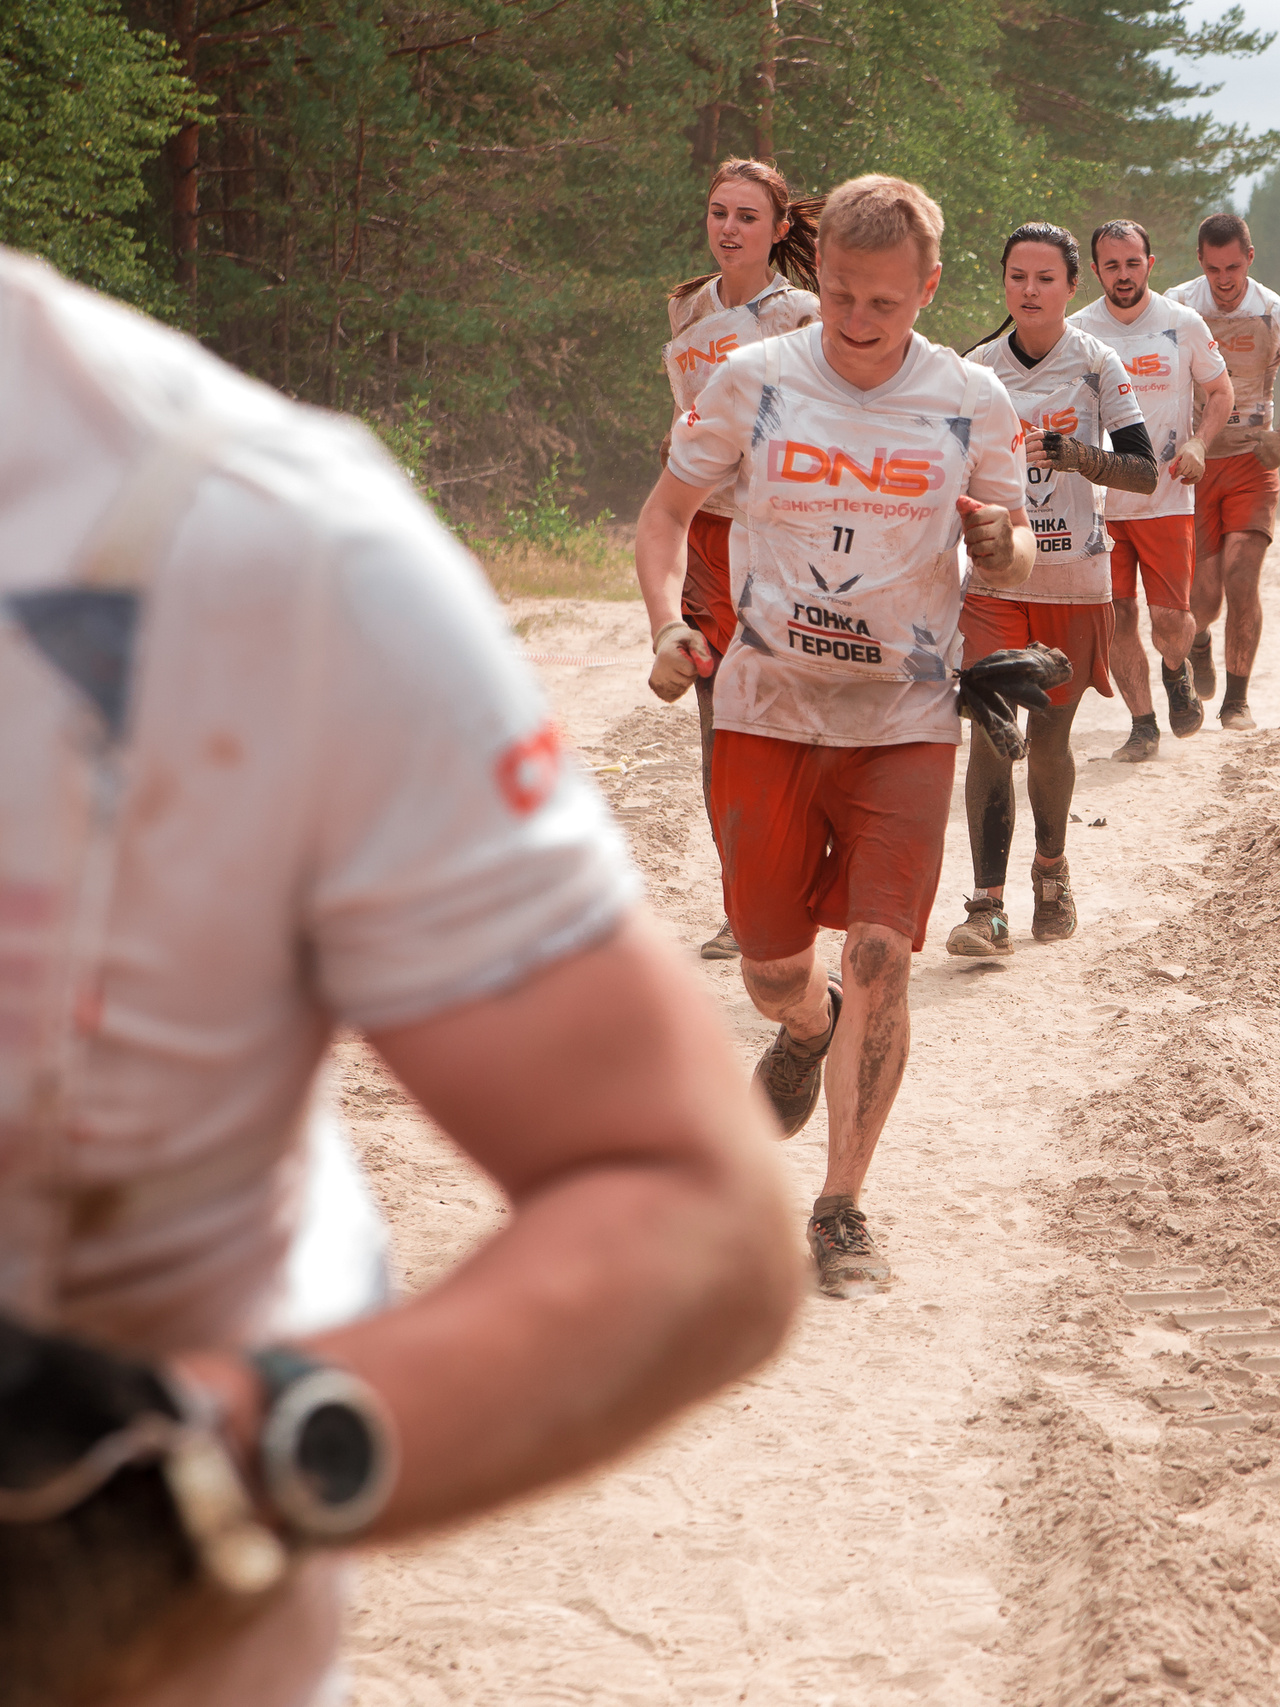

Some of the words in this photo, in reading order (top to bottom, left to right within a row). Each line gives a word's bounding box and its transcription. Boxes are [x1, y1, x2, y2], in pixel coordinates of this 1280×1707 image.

[1215, 335, 1256, 352] NS
[1122, 353, 1160, 375] NS
[1019, 406, 1079, 437] NS
[781, 440, 931, 498] DNS
[769, 495, 939, 522] Санкт-Петербург
[833, 525, 855, 555] 11
[794, 601, 872, 638] ГОНКА
[788, 628, 882, 664] ГЕРОЕВ
